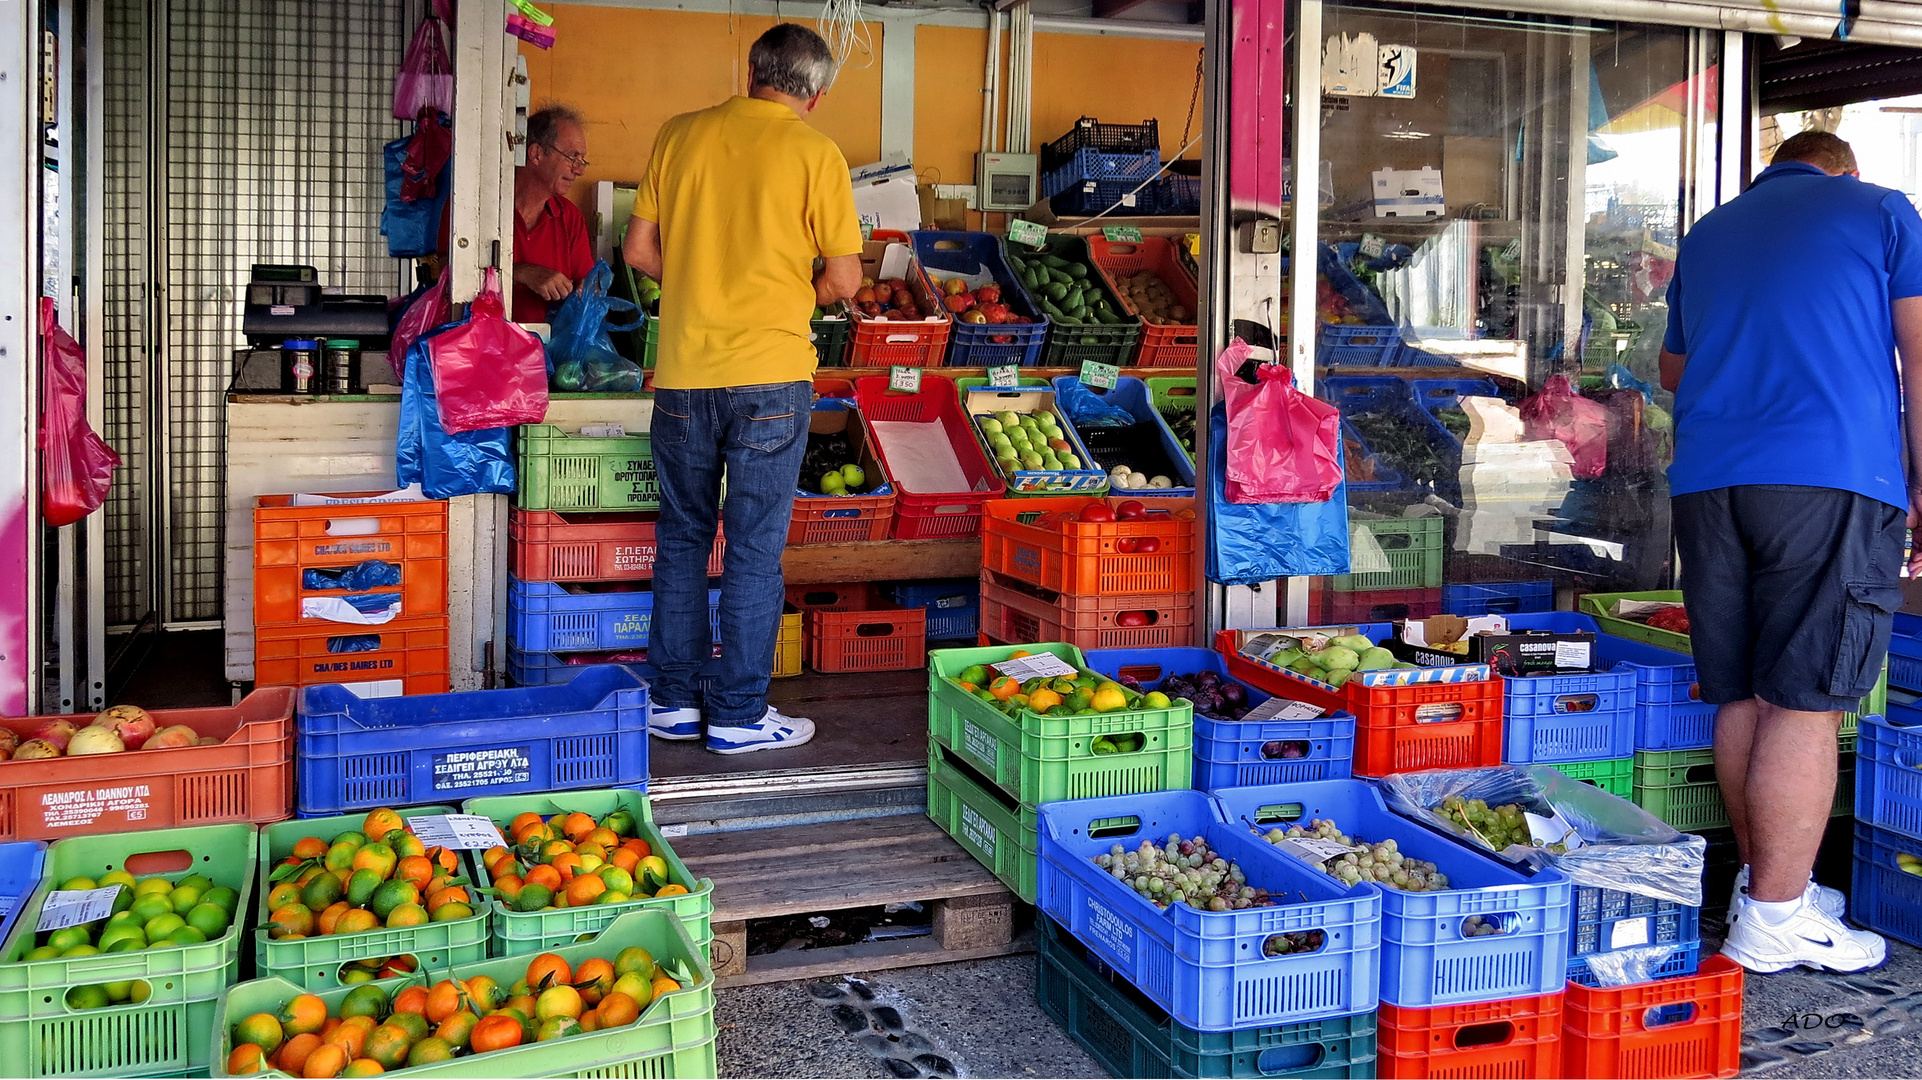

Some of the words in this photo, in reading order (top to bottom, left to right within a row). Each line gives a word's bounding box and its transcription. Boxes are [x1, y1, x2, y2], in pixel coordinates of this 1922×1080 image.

[378, 542, 391, 551] LTD
[1520, 642, 1556, 652] casanova
[350, 660, 378, 671] DAIRES
[380, 659, 394, 668] LTD
[1415, 651, 1455, 667] casanova
[446, 748, 517, 763] ΠΕΡΙΦΕΡΕΙΑΚΗ
[434, 762, 475, 774] ΣΕΔΙΓΕΠ
[511, 757, 529, 768] ΛΤΔ
[490, 776, 514, 785] ΑΓΡΟΣ
[42, 790, 86, 806] ΛΕΑΝΔΡΟΣ
[86, 790, 95, 802] Λ.
[96, 786, 134, 801] ΙΩΑΝΝΟΥ
[134, 784, 150, 797] ΛΤΔ
[49, 801, 105, 812] ΧΟΝΔΡΙΚΗ
[107, 797, 142, 807] ΑΓΟΡΑ
[46, 818, 94, 828] ΛΕΜΕΣΟΣ
[1087, 896, 1133, 938] CHRISTODOULOS
[1096, 913, 1112, 932] FARM
[1112, 925, 1123, 940] LTD
[1089, 924, 1116, 951] FRENAROS
